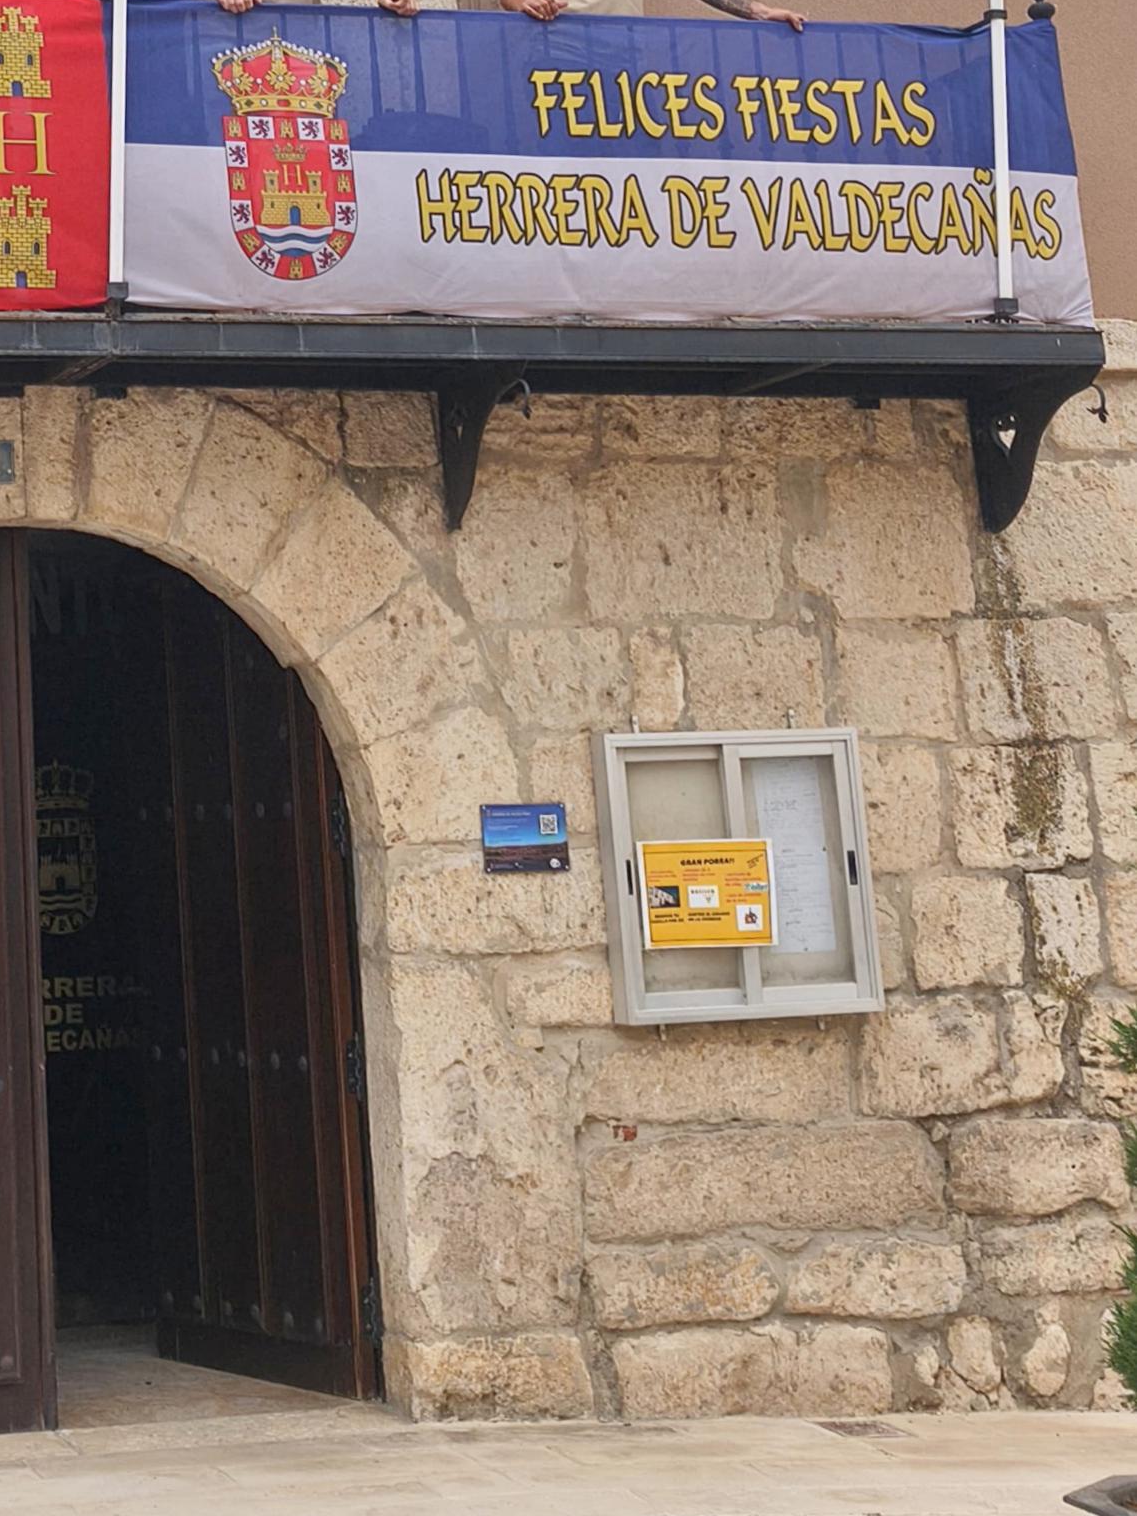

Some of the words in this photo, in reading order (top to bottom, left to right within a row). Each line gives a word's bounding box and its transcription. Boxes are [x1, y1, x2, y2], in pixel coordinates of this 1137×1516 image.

[528, 69, 726, 141] FELICES
[731, 74, 937, 148] FIESTAS
[415, 169, 659, 249] HERRERA
[662, 175, 737, 249] DE
[44, 1002, 85, 1025] DE
